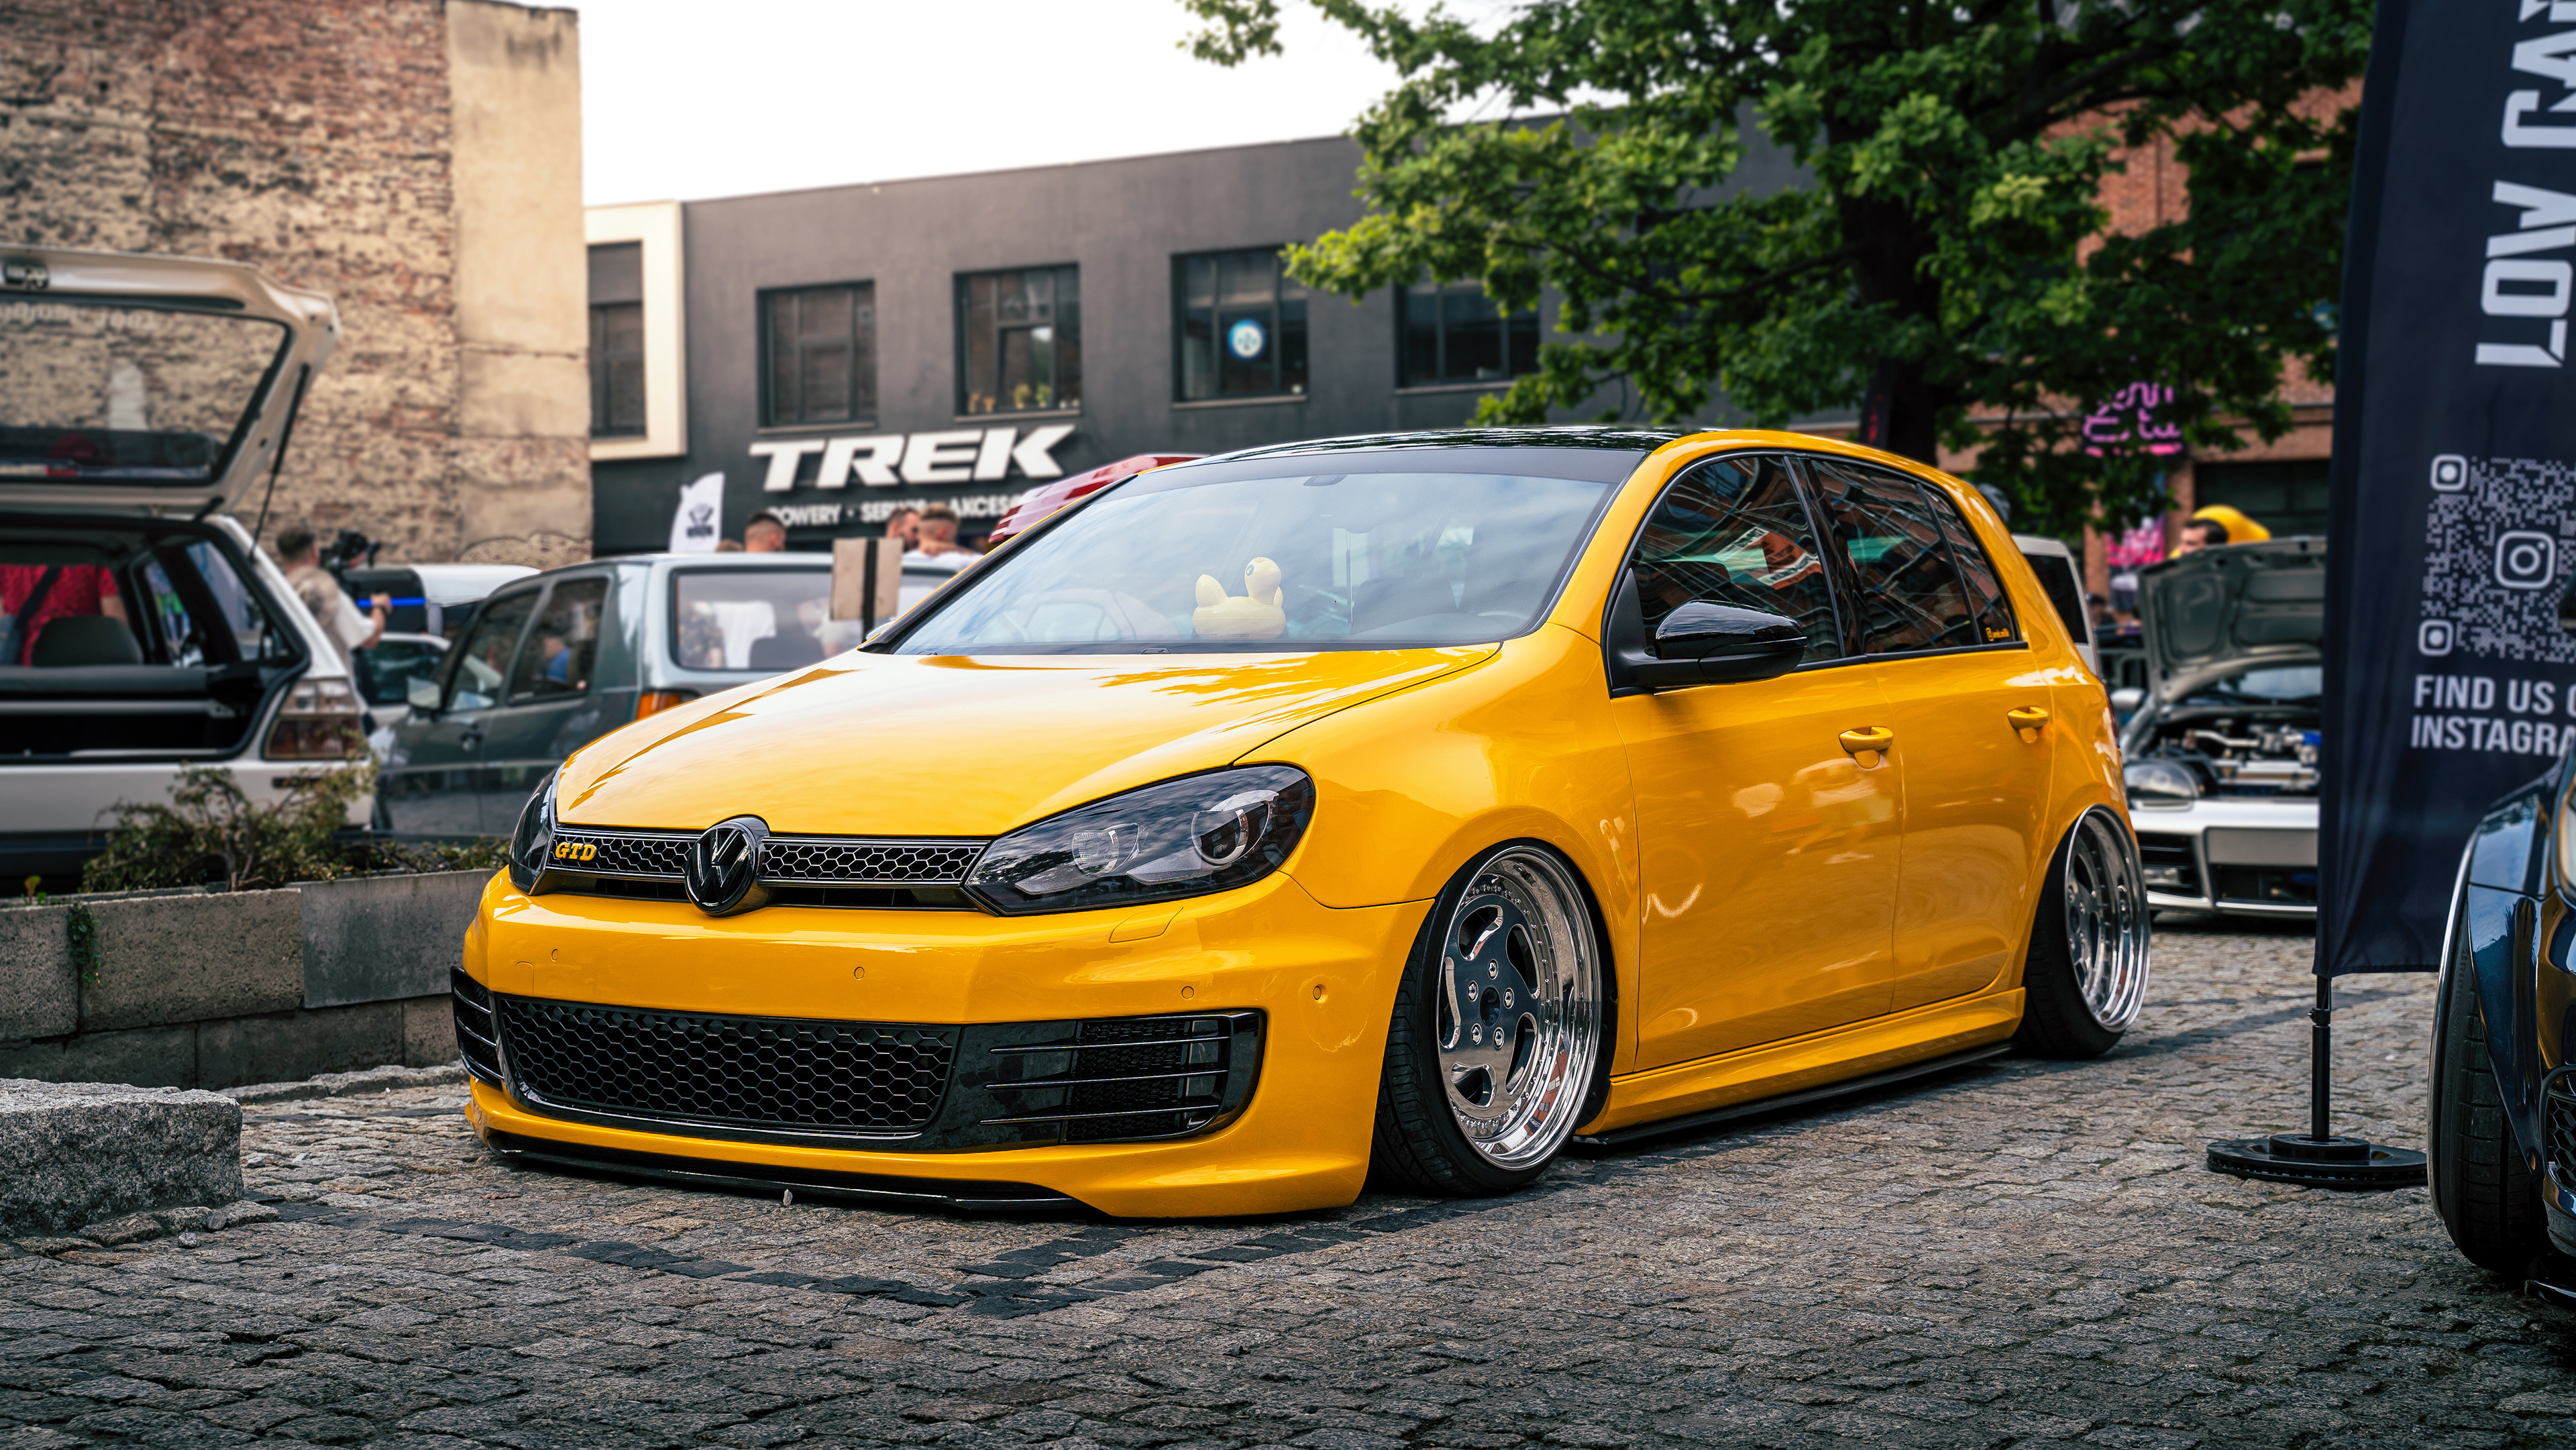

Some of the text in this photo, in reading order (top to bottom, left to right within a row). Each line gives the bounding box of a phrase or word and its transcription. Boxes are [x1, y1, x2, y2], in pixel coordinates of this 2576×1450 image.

[2475, 179, 2576, 368] LOW
[750, 425, 1075, 492] TREK
[2414, 675, 2496, 711] FIND
[2507, 678, 2556, 715] US
[555, 841, 597, 861] GTD
